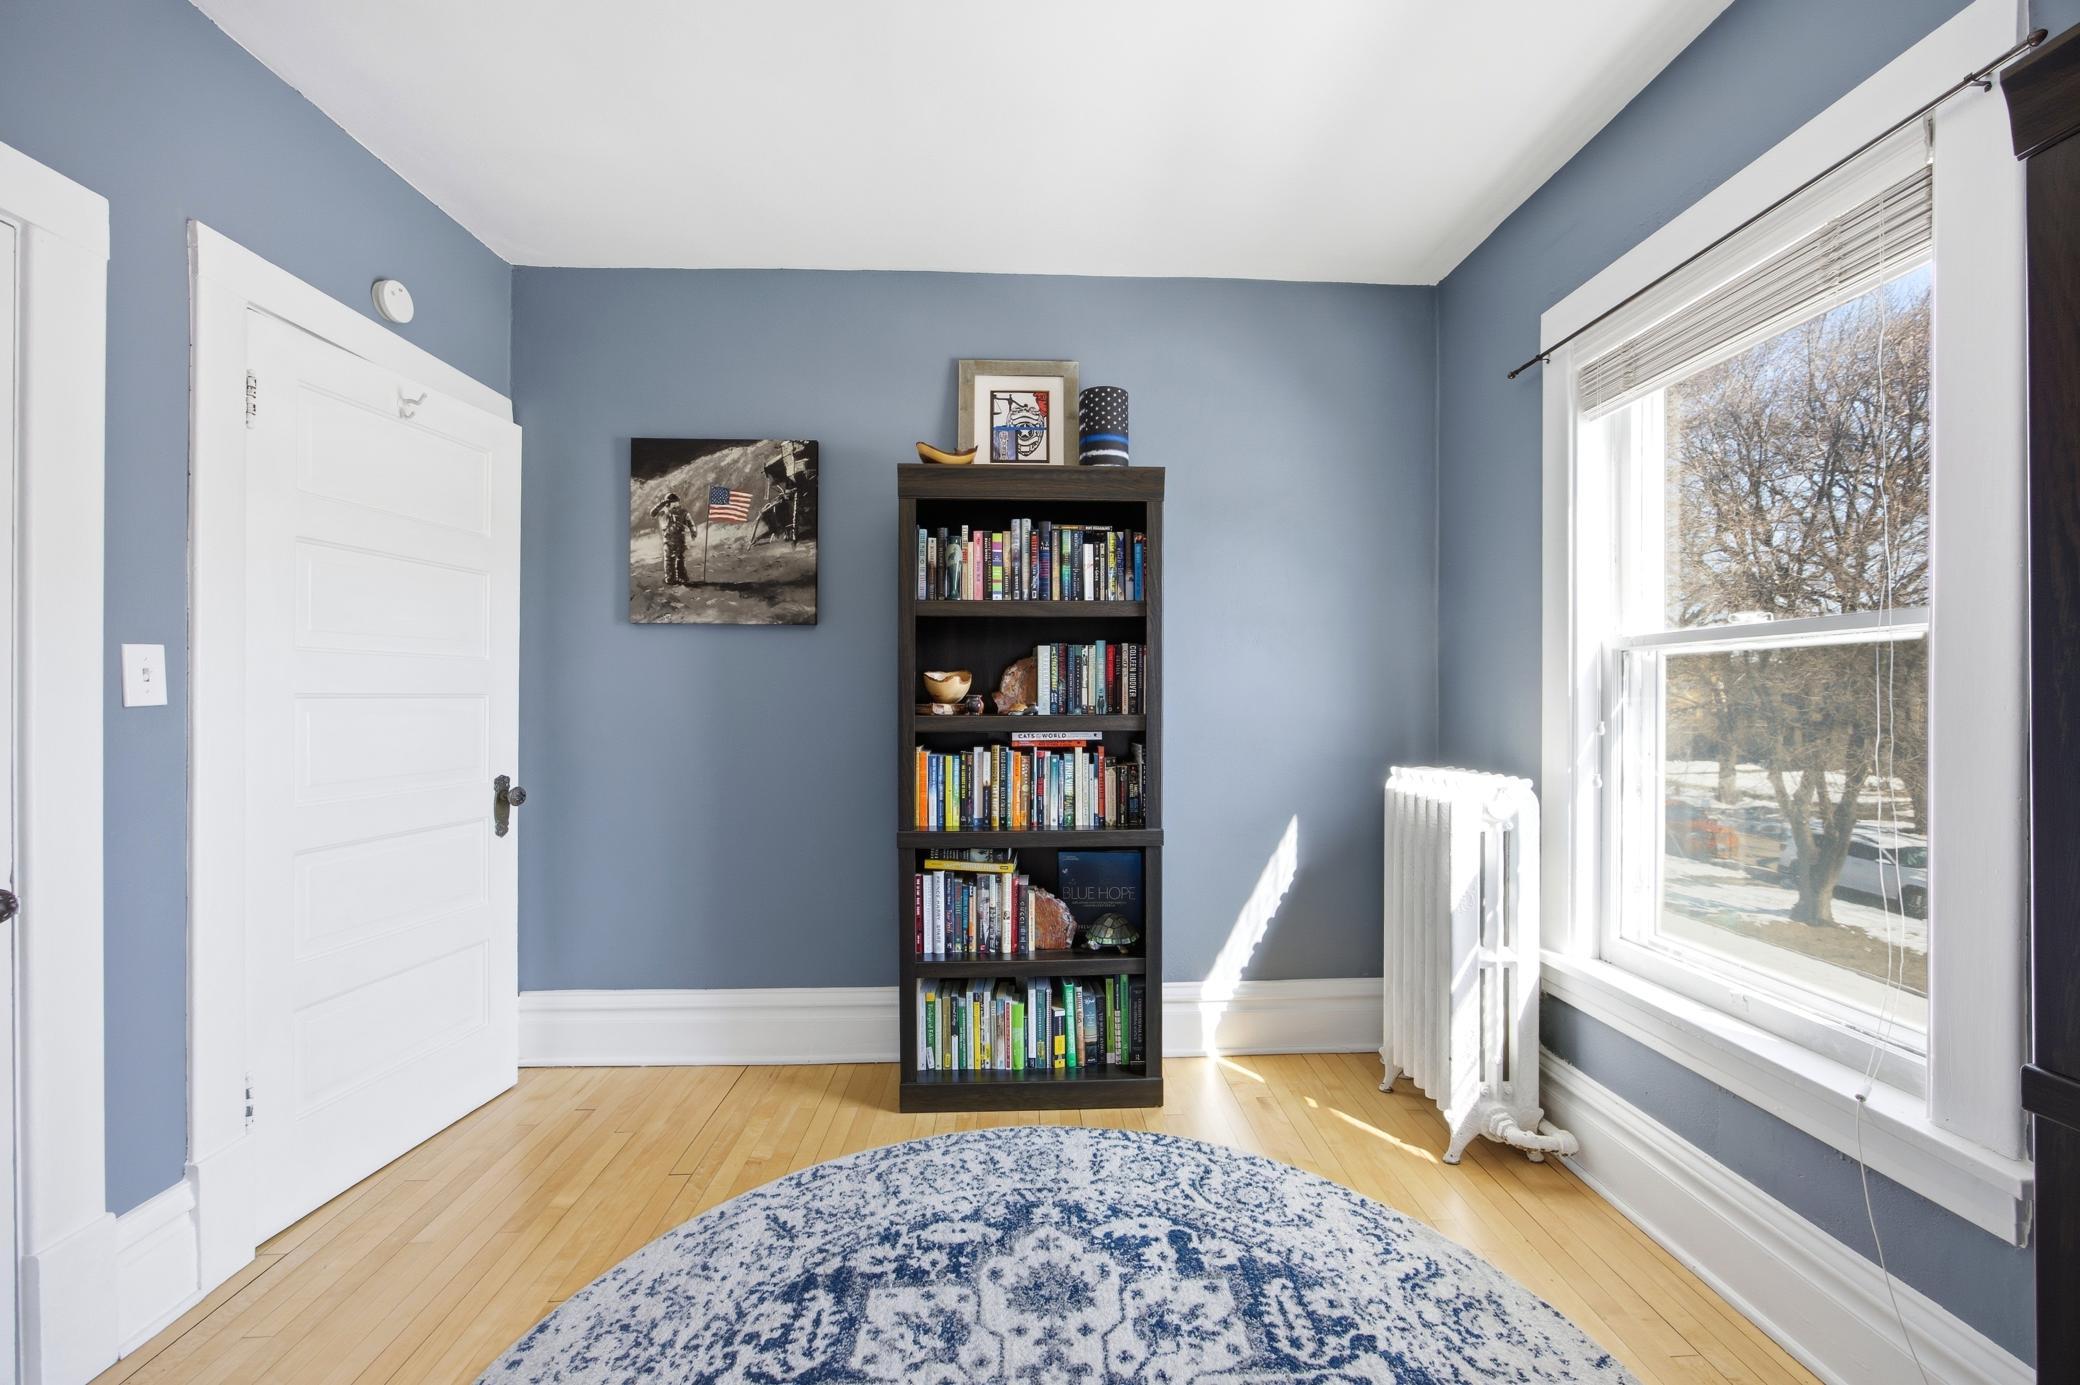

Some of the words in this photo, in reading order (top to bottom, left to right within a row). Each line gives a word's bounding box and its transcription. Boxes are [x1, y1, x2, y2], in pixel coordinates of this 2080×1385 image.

[1129, 645, 1137, 672] COLLEEN
[1129, 673, 1137, 697] HOOVER
[1062, 886, 1096, 900] BLUE
[1098, 886, 1136, 900] HOPE
